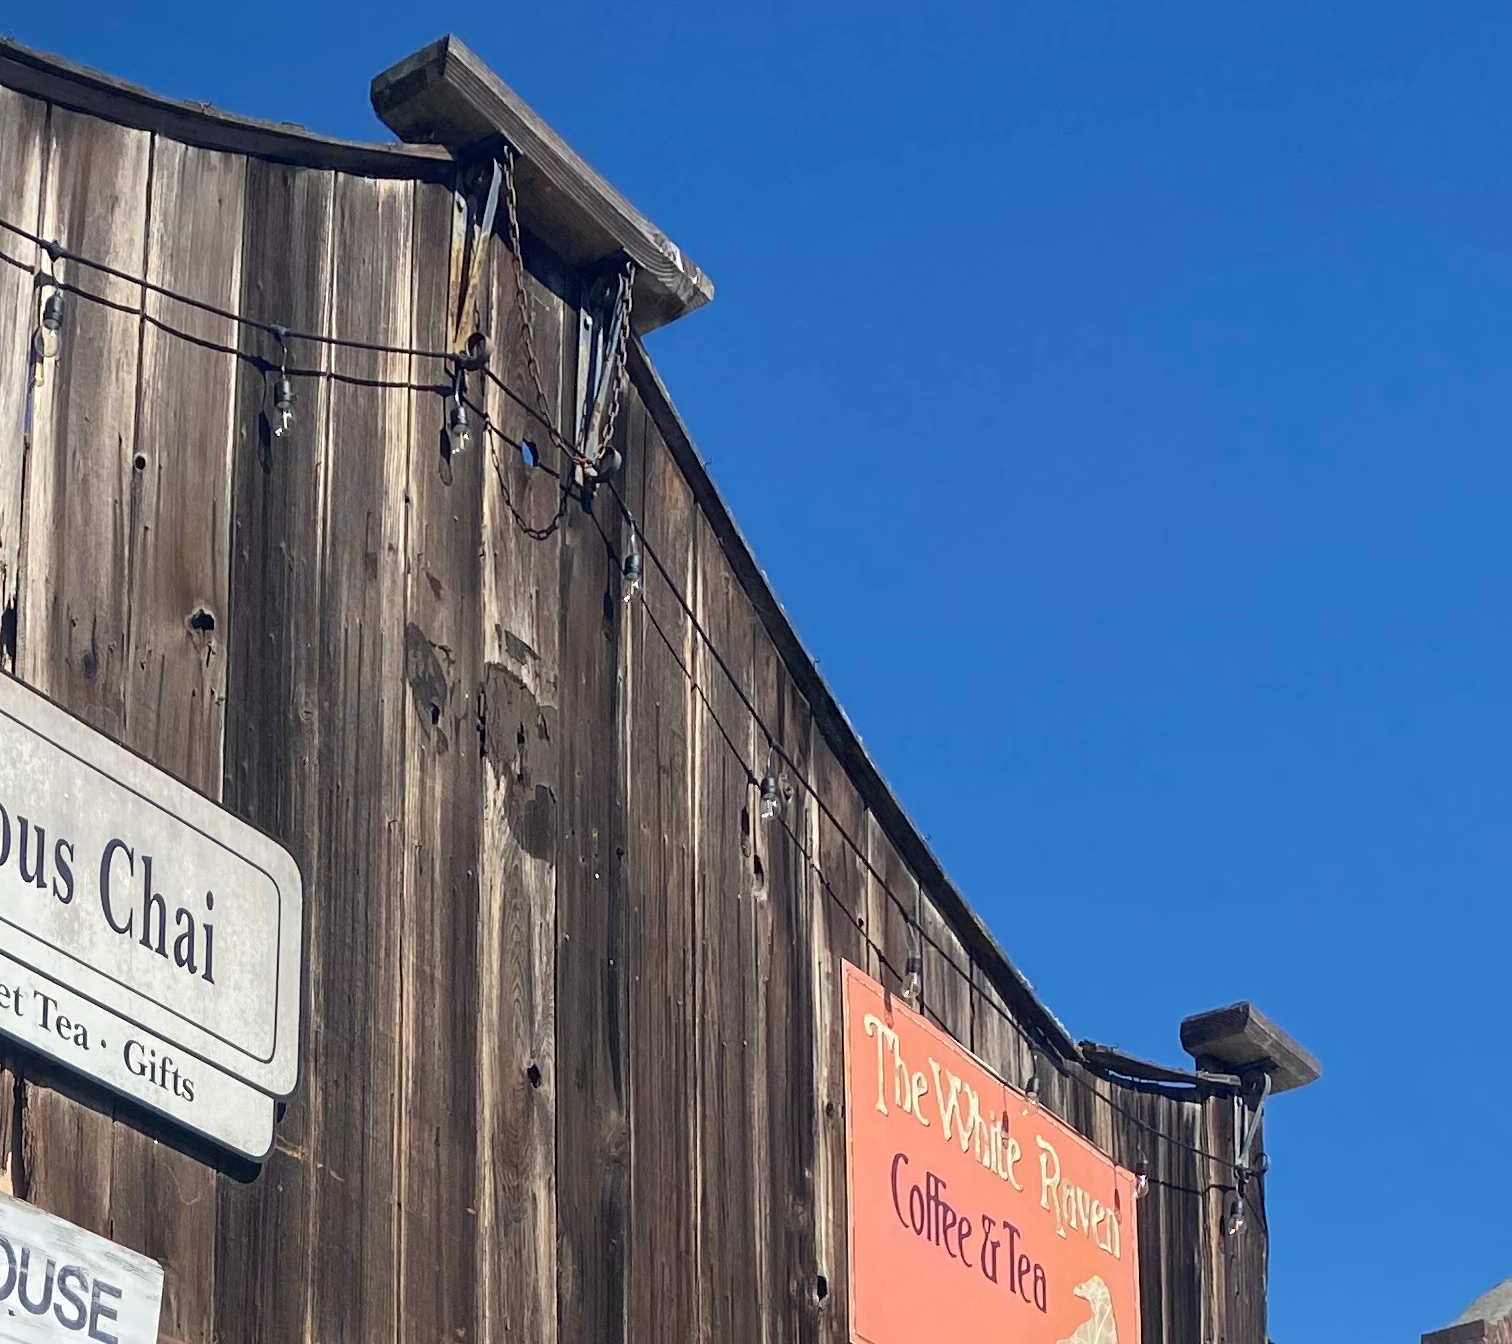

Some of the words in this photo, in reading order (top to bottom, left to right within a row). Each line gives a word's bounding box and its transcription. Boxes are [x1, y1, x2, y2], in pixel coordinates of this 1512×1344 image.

[99, 837, 216, 985] Chai
[33, 990, 90, 1050] Tea
[123, 1039, 196, 1103] Gifts
[863, 1012, 930, 1127] The
[928, 1056, 1024, 1193] White
[1036, 1134, 1122, 1260] Raven
[891, 1153, 973, 1269] Coffee
[1002, 1220, 1047, 1313] Tea
